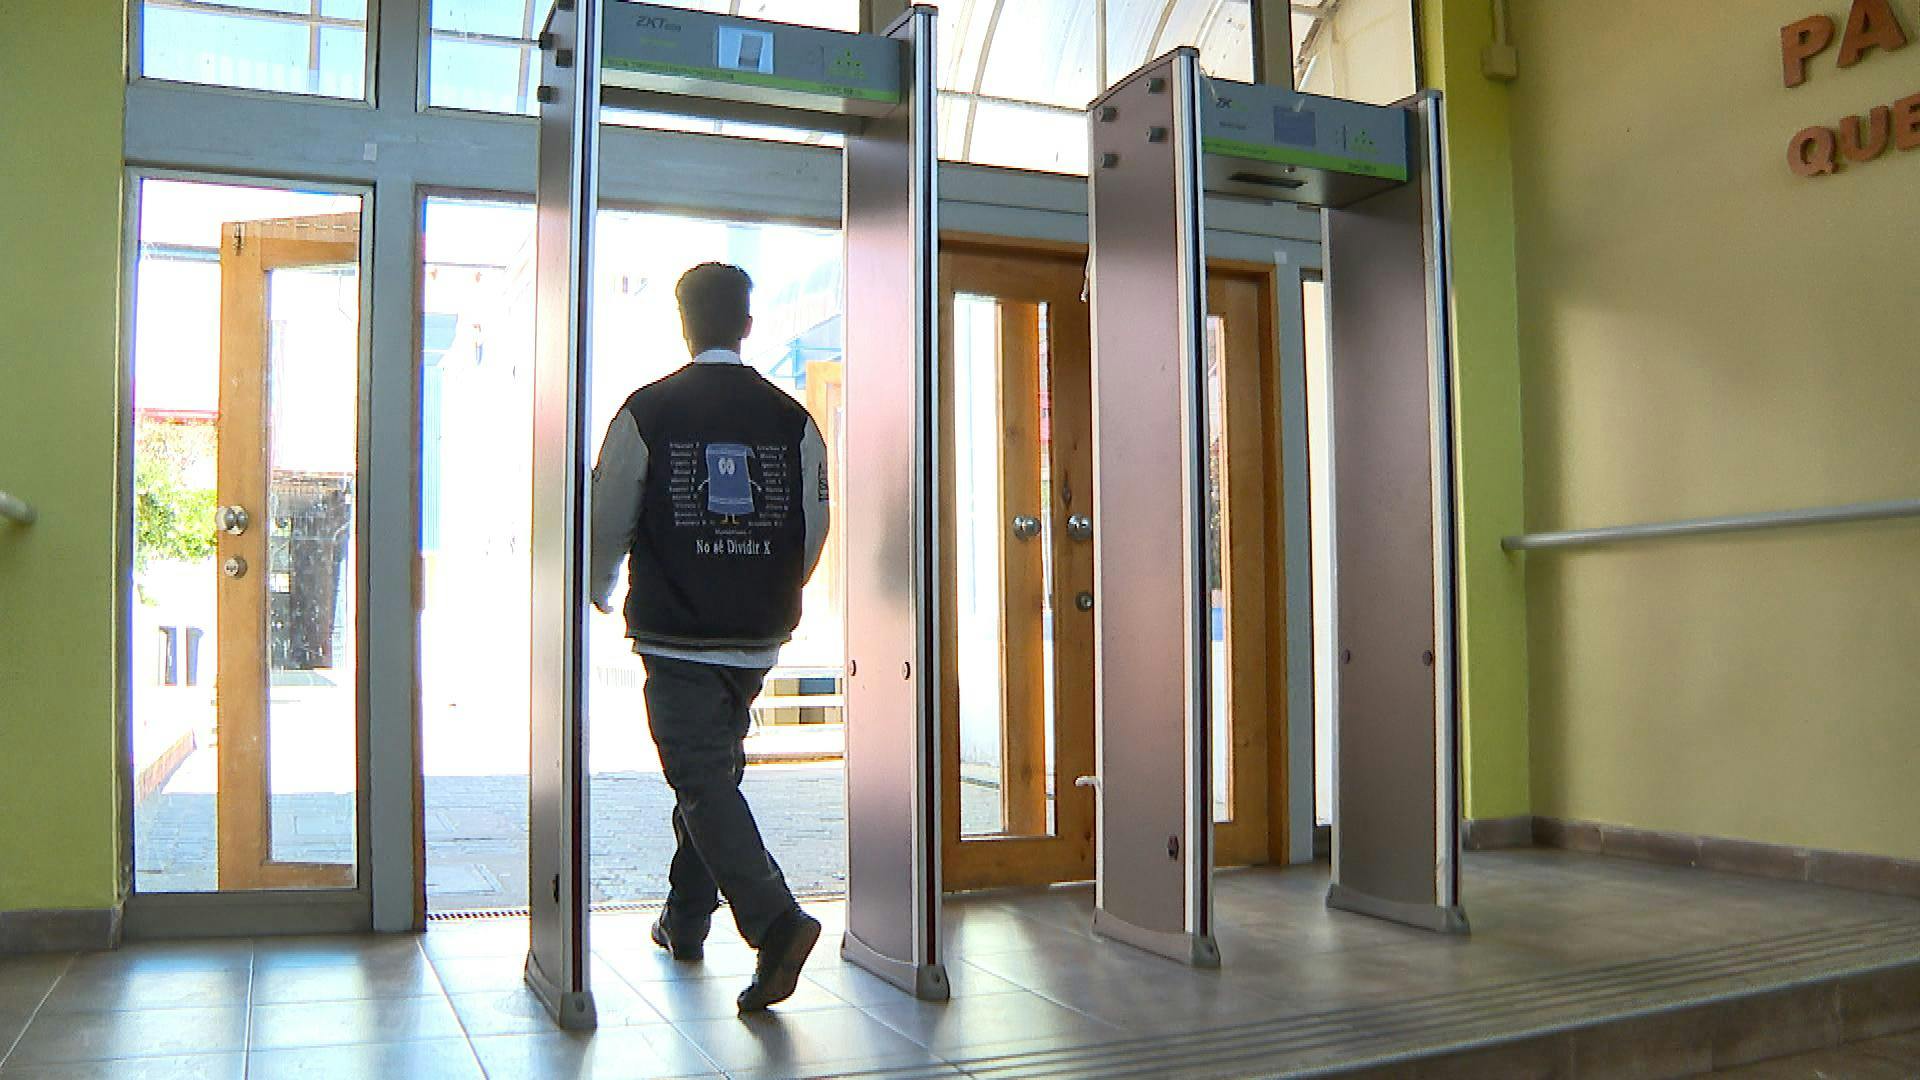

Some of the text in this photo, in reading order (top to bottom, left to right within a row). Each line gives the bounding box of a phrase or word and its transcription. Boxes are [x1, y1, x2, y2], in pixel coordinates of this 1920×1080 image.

[1787, 93, 1920, 177] QUE
[695, 539, 771, 555] No sé Dividir X
